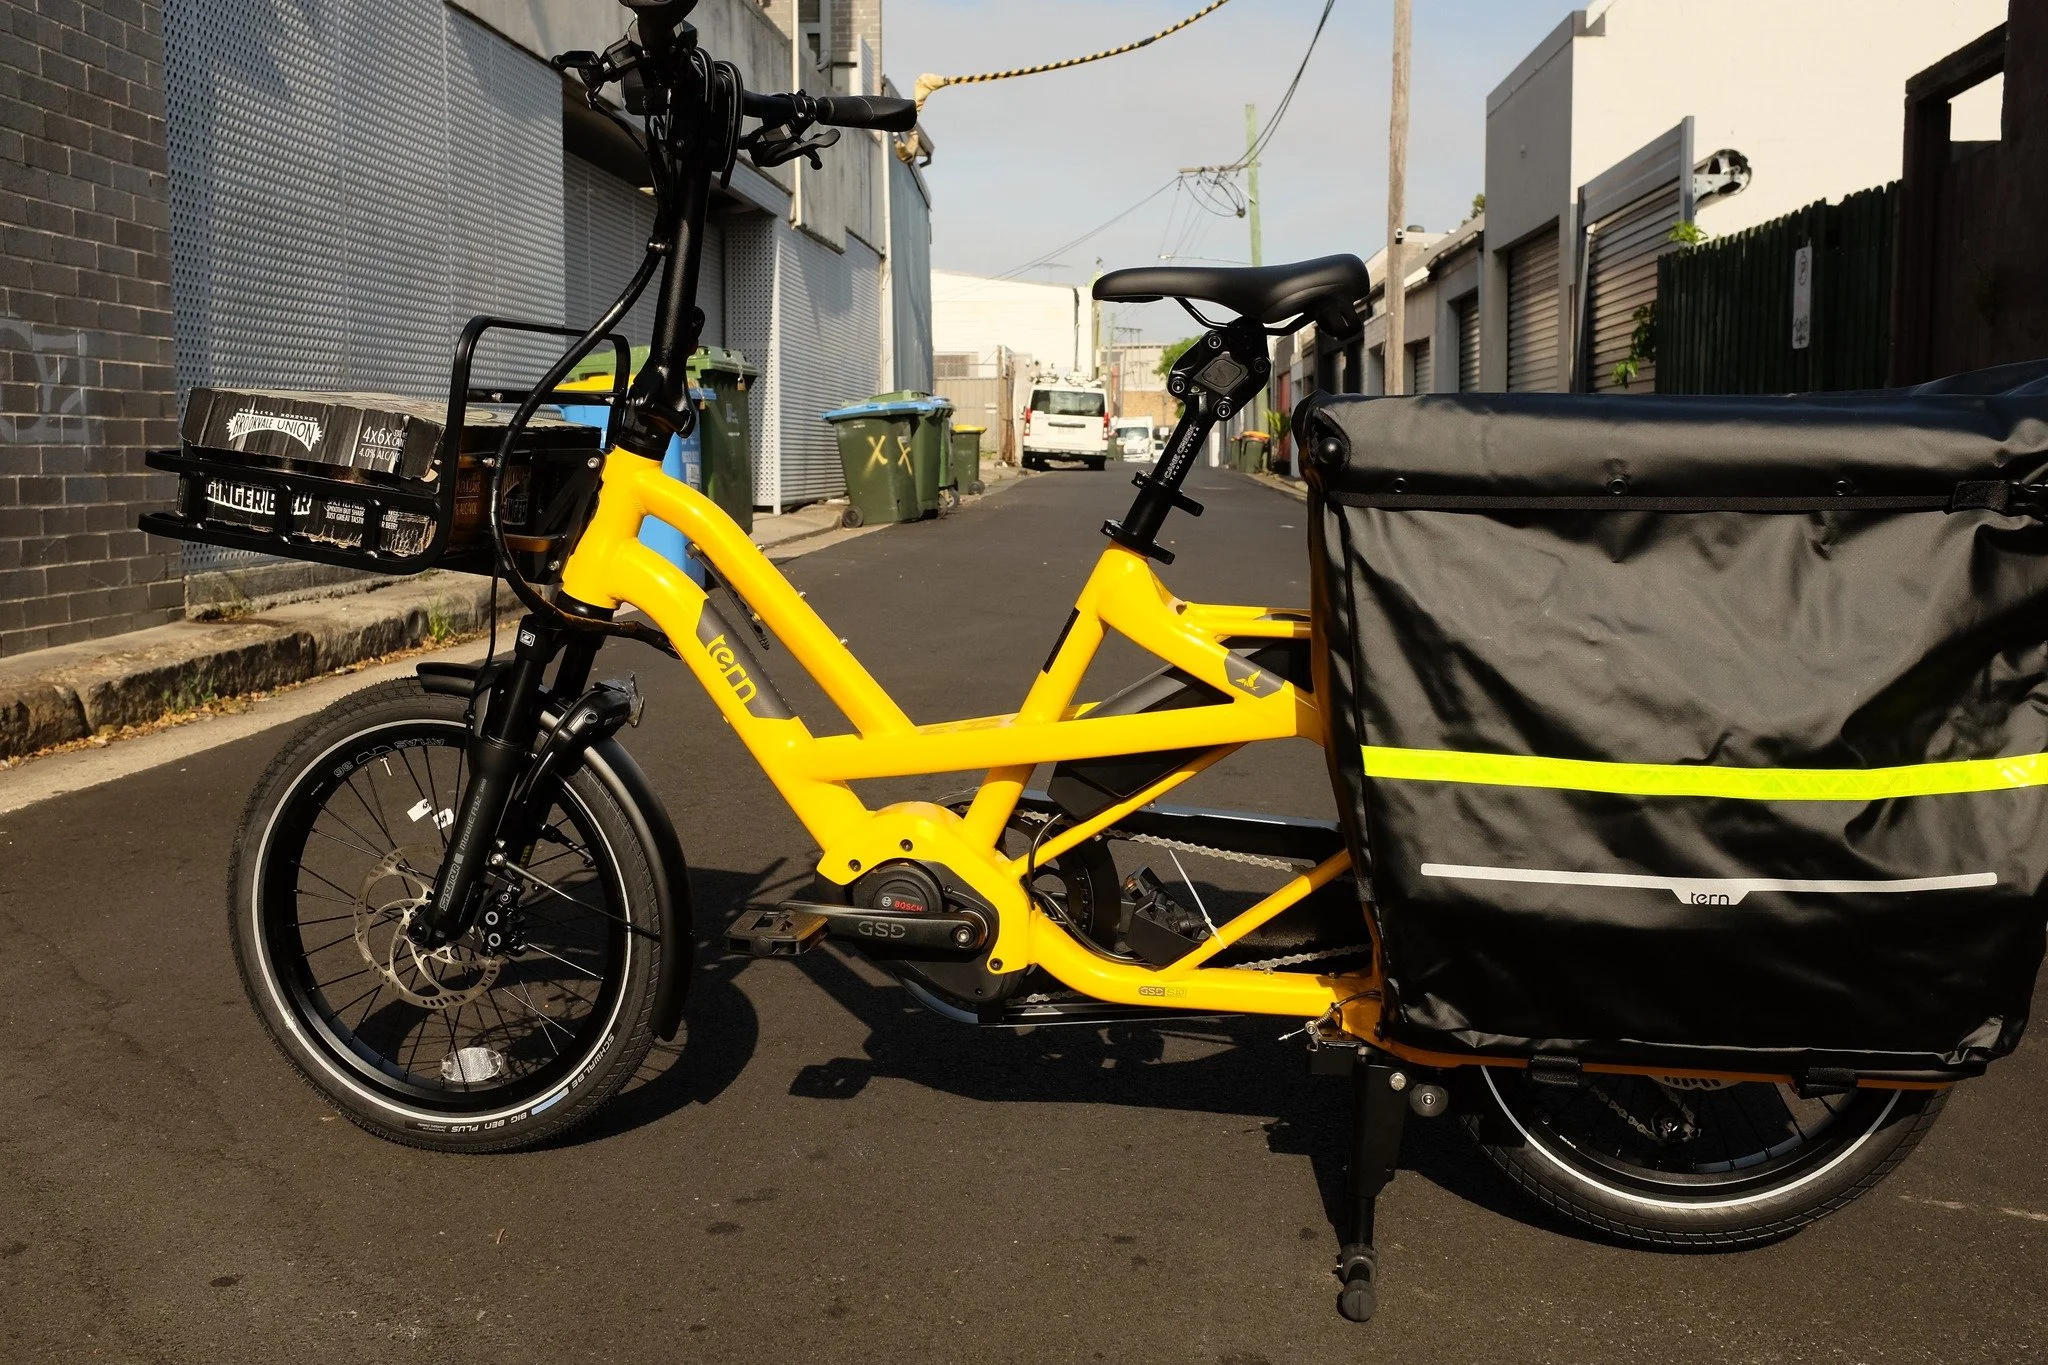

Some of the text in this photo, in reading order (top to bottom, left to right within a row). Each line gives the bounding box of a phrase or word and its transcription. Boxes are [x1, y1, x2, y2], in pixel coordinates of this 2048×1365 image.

[232, 414, 273, 435] BROOKVALE
[277, 419, 316, 447] UNION
[707, 634, 757, 704] tern
[1690, 892, 1730, 906] tern
[894, 900, 923, 912] BOSCH
[858, 920, 906, 939] GSD
[1140, 987, 1164, 996] GSD
[571, 1032, 615, 1090] SCHWALBE
[484, 1119, 505, 1130] BEN
[510, 1112, 527, 1124] BIG
[450, 1125, 480, 1133] PLUS
